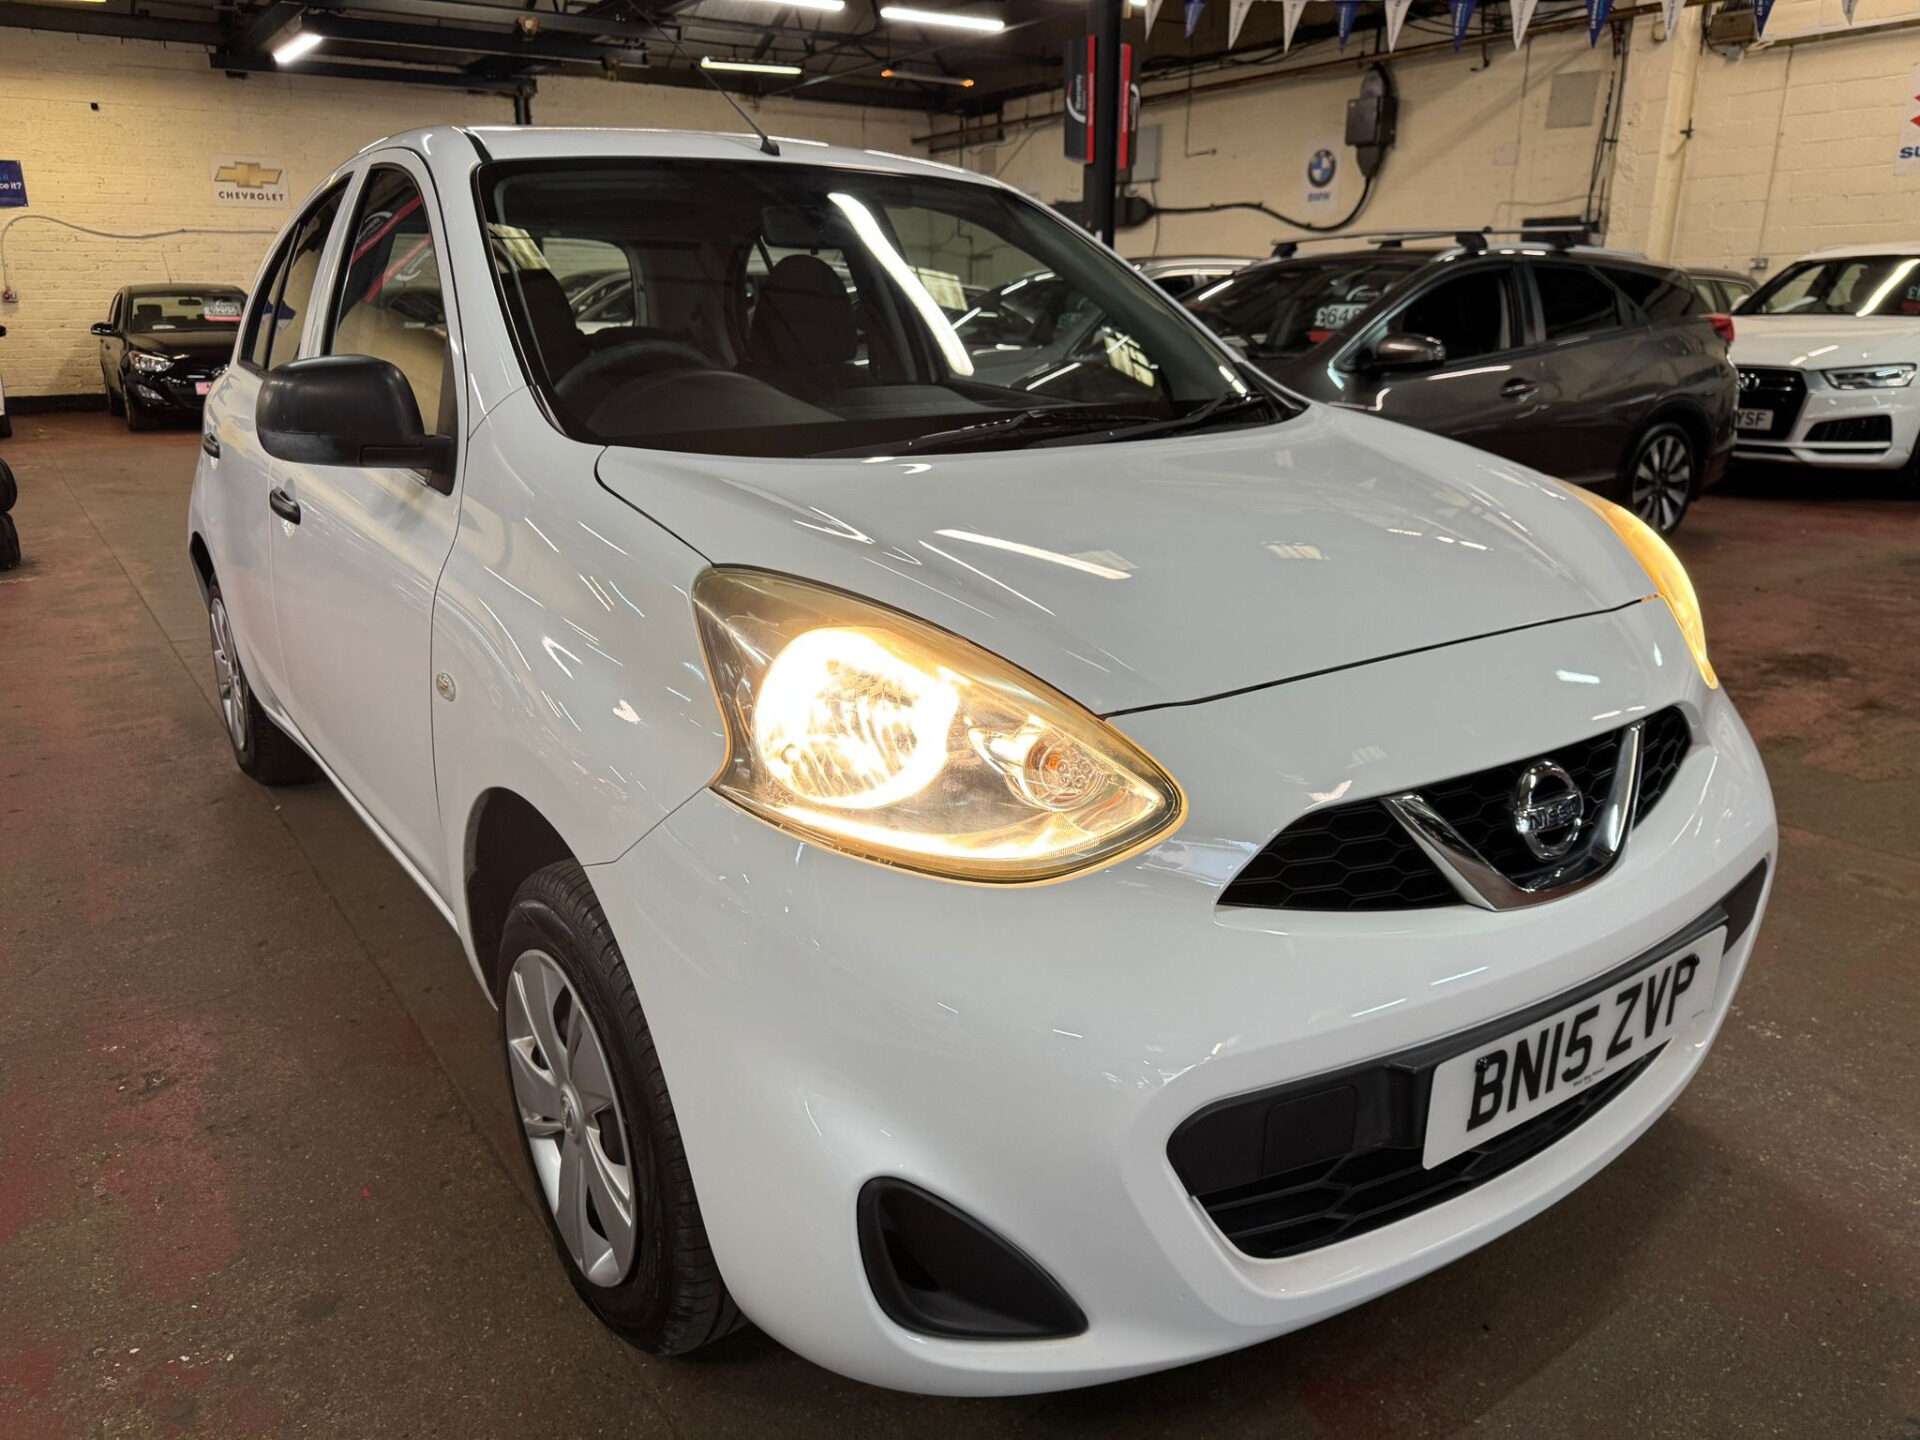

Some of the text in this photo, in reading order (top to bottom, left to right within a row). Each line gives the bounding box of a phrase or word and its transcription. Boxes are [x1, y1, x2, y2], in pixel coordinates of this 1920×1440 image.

[218, 191, 284, 201] CHEVROLET
[1466, 952, 1699, 1132] BN15 ZVP
